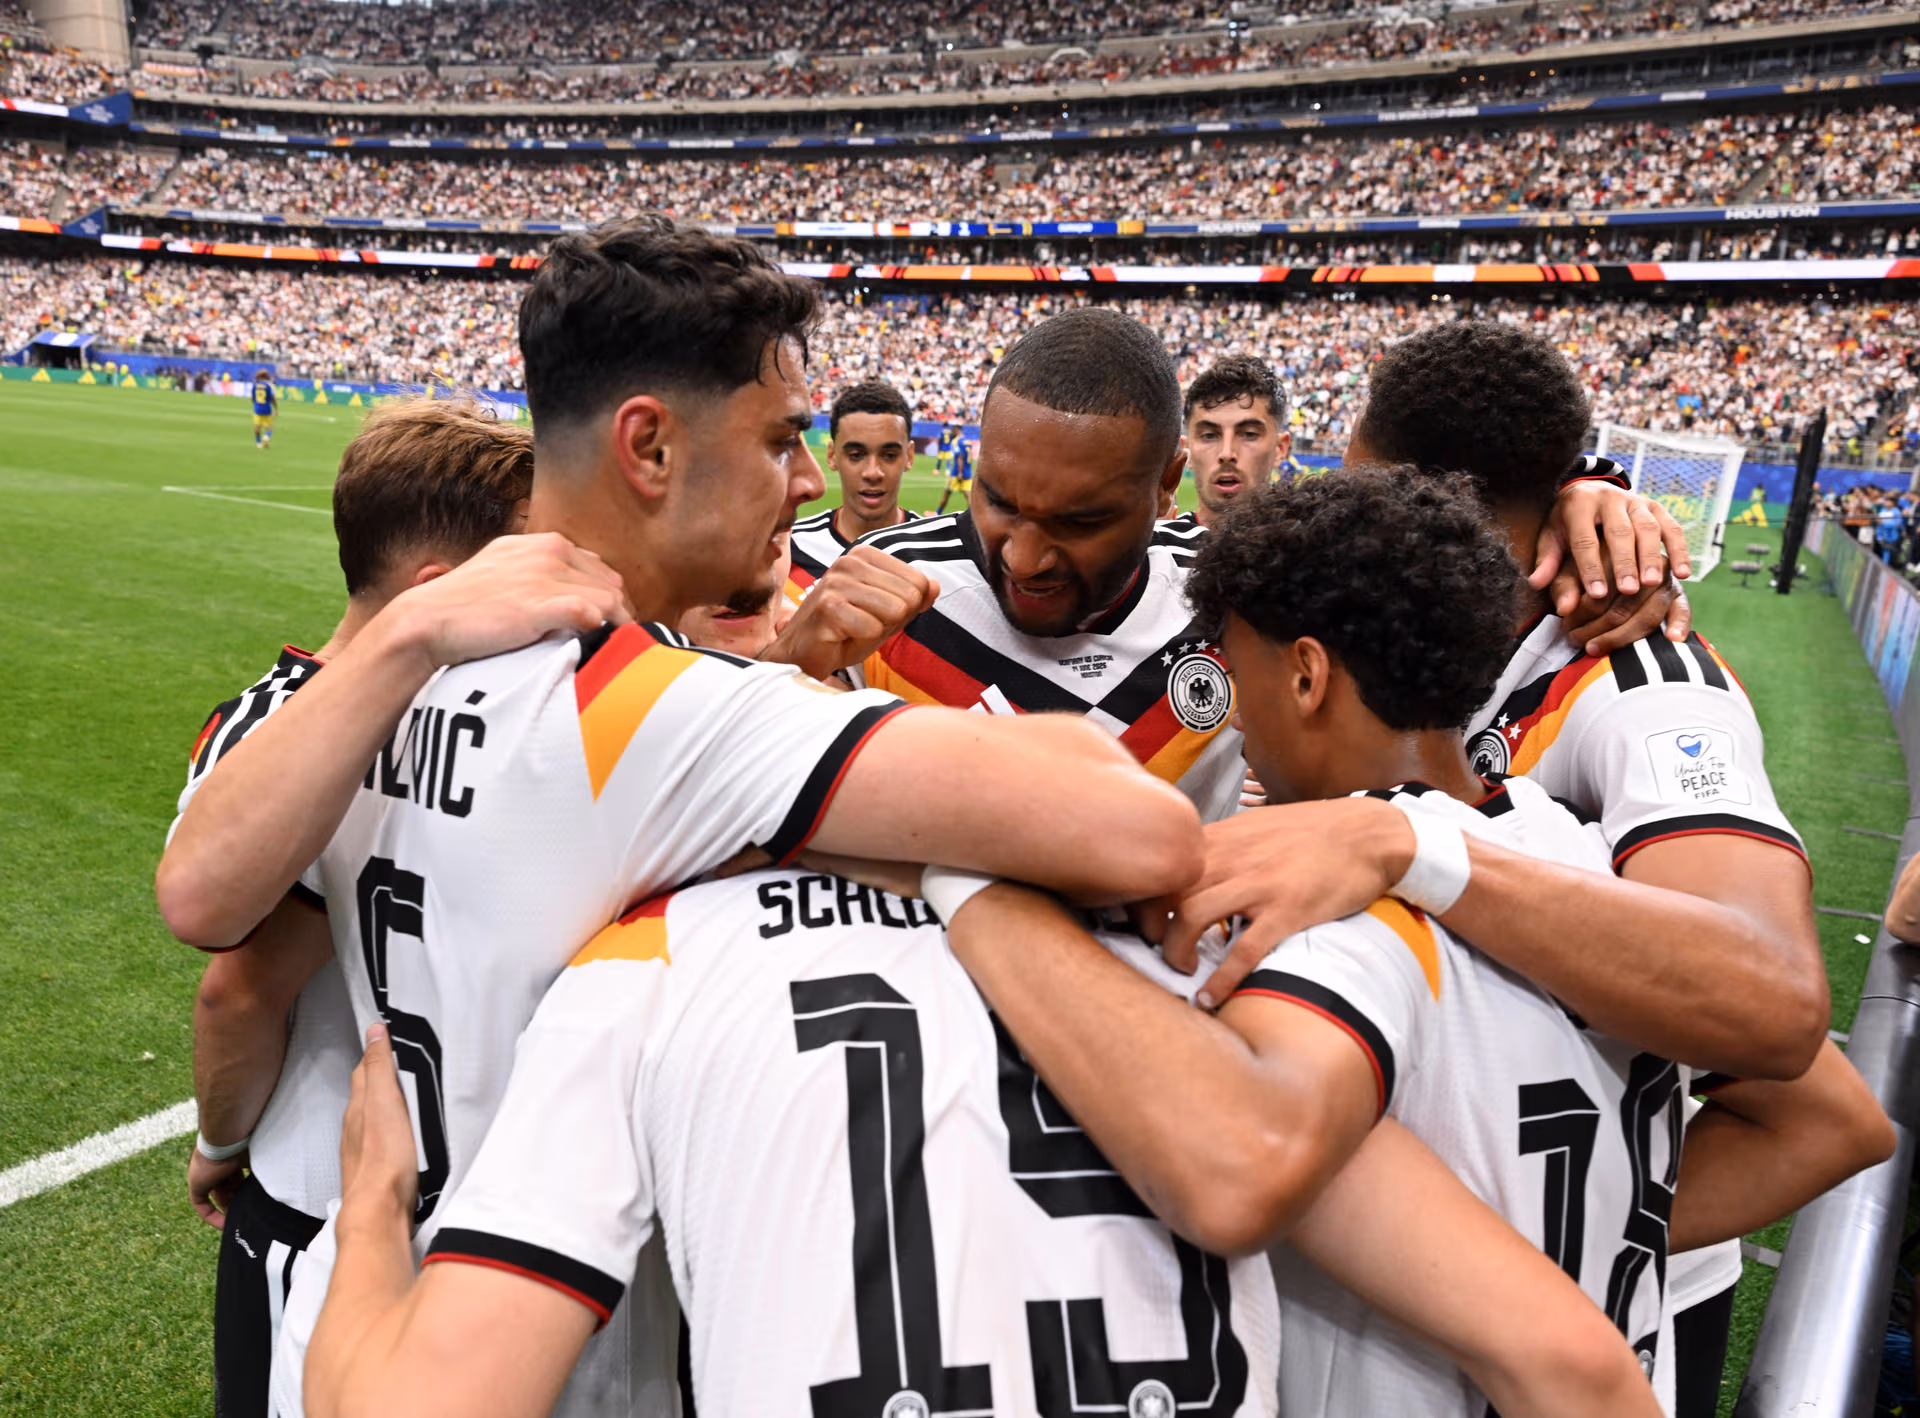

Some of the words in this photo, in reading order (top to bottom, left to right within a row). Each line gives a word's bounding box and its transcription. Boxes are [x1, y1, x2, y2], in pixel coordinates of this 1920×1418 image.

[1724, 206, 1820, 220] HOUSTON
[1181, 666, 1214, 683] DEUTSCHER
[1184, 697, 1224, 720] FUSSBALL-BUND
[1680, 771, 1728, 793] PEACE
[1694, 788, 1720, 800] FIFA
